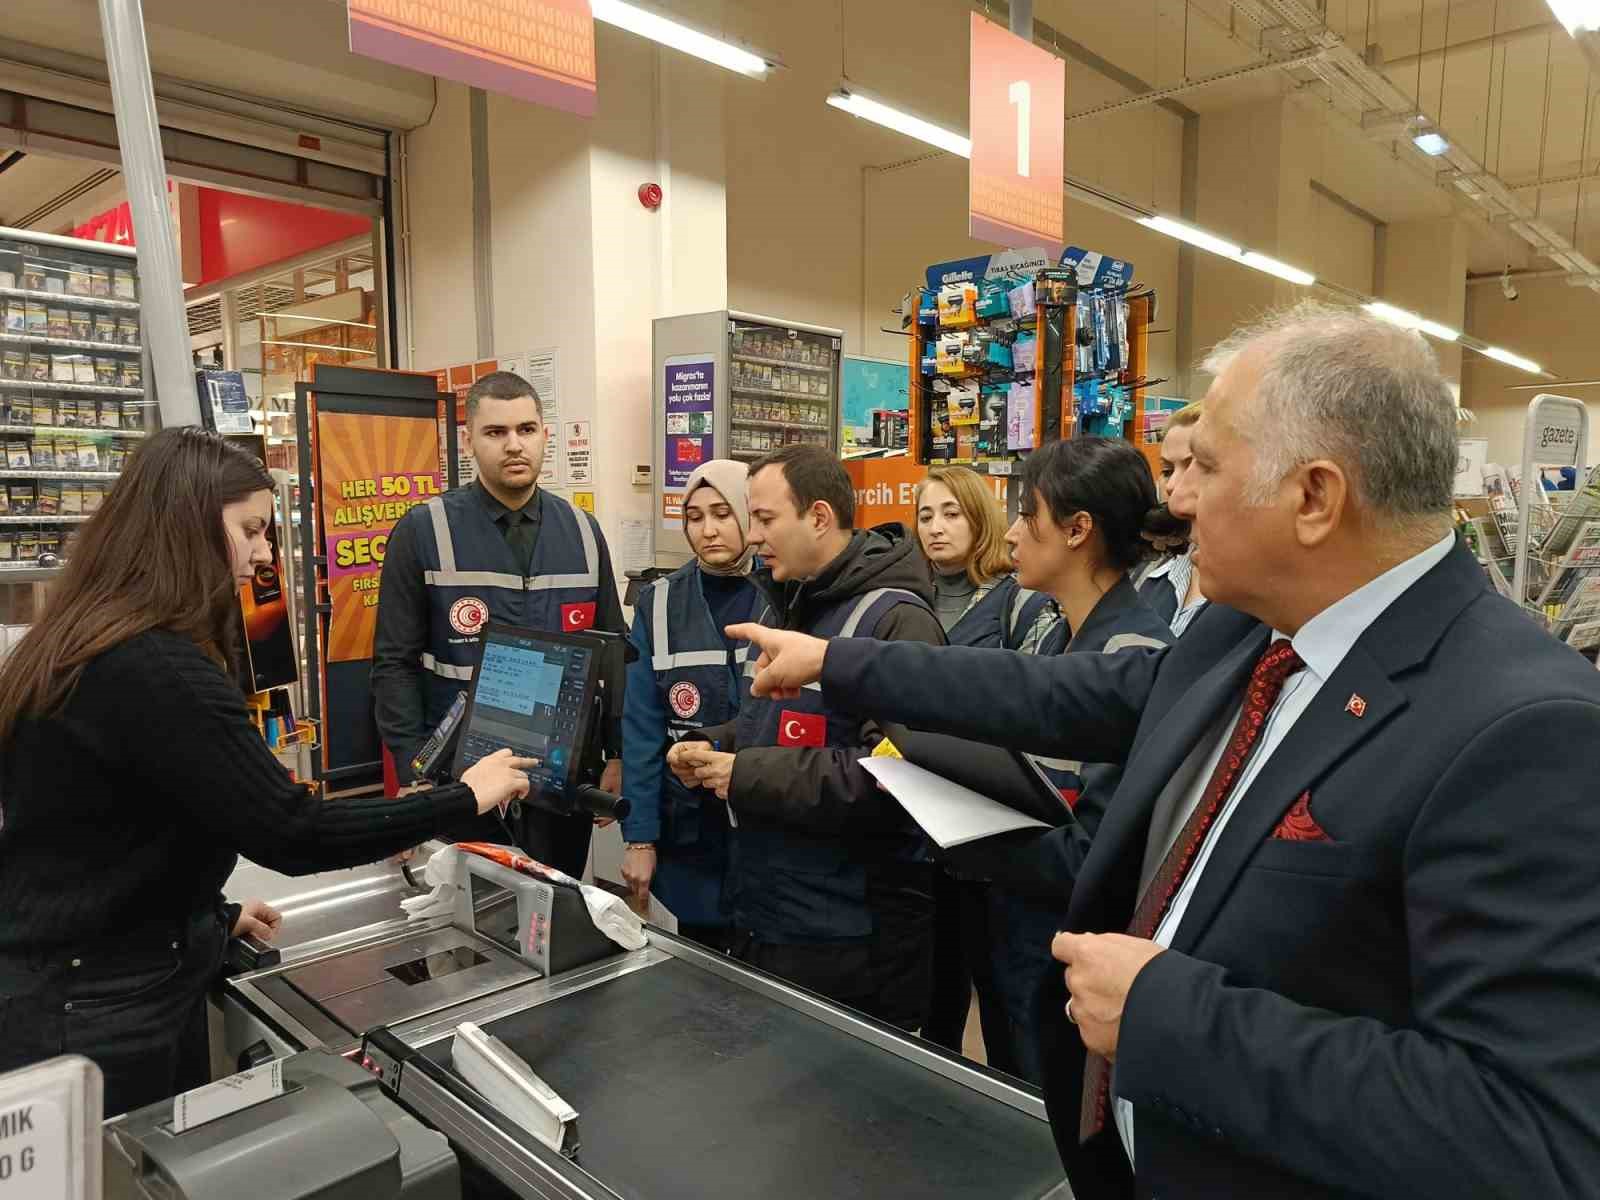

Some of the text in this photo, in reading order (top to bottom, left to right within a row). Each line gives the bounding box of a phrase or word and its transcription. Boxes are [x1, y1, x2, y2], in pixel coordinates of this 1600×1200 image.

[1007, 80, 1030, 177] 1
[942, 270, 974, 284] Gillette
[1541, 425, 1575, 448] gazete
[341, 475, 440, 498] HER 50 TL
[21, 1147, 35, 1172] G
